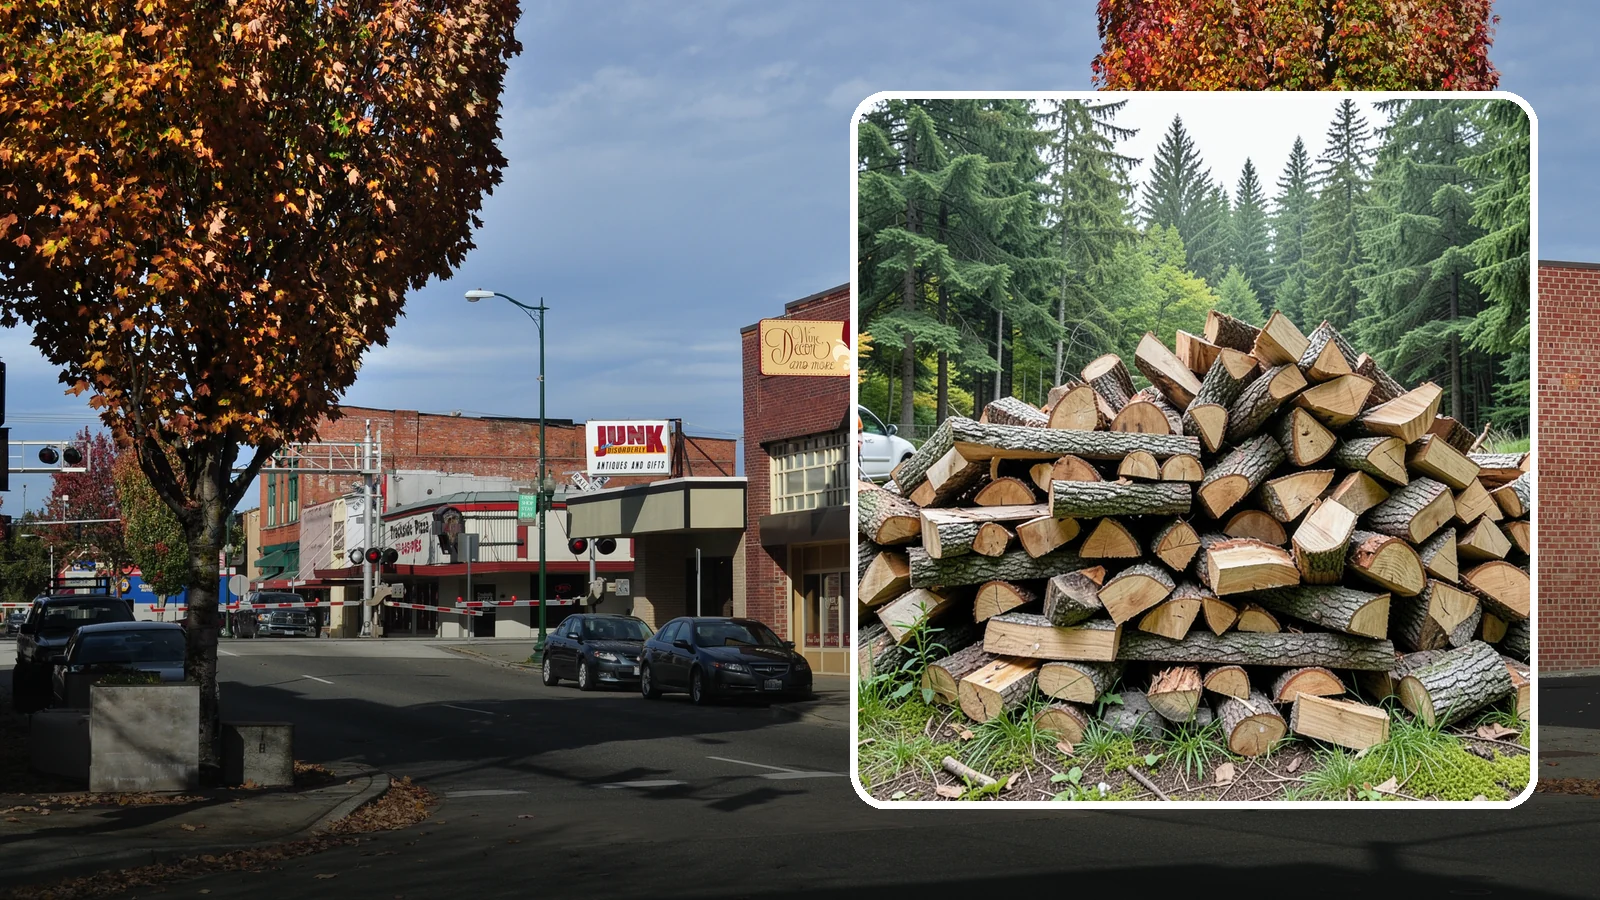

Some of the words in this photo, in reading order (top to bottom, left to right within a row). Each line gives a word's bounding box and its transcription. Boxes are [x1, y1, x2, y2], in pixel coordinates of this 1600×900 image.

[595, 425, 665, 457] JUNK
[608, 446, 646, 454] DISORDERLY
[597, 461, 628, 470] ANTIQUES
[631, 461, 644, 470] AND
[647, 460, 665, 469] GIFTS
[415, 520, 429, 534] Pizza
